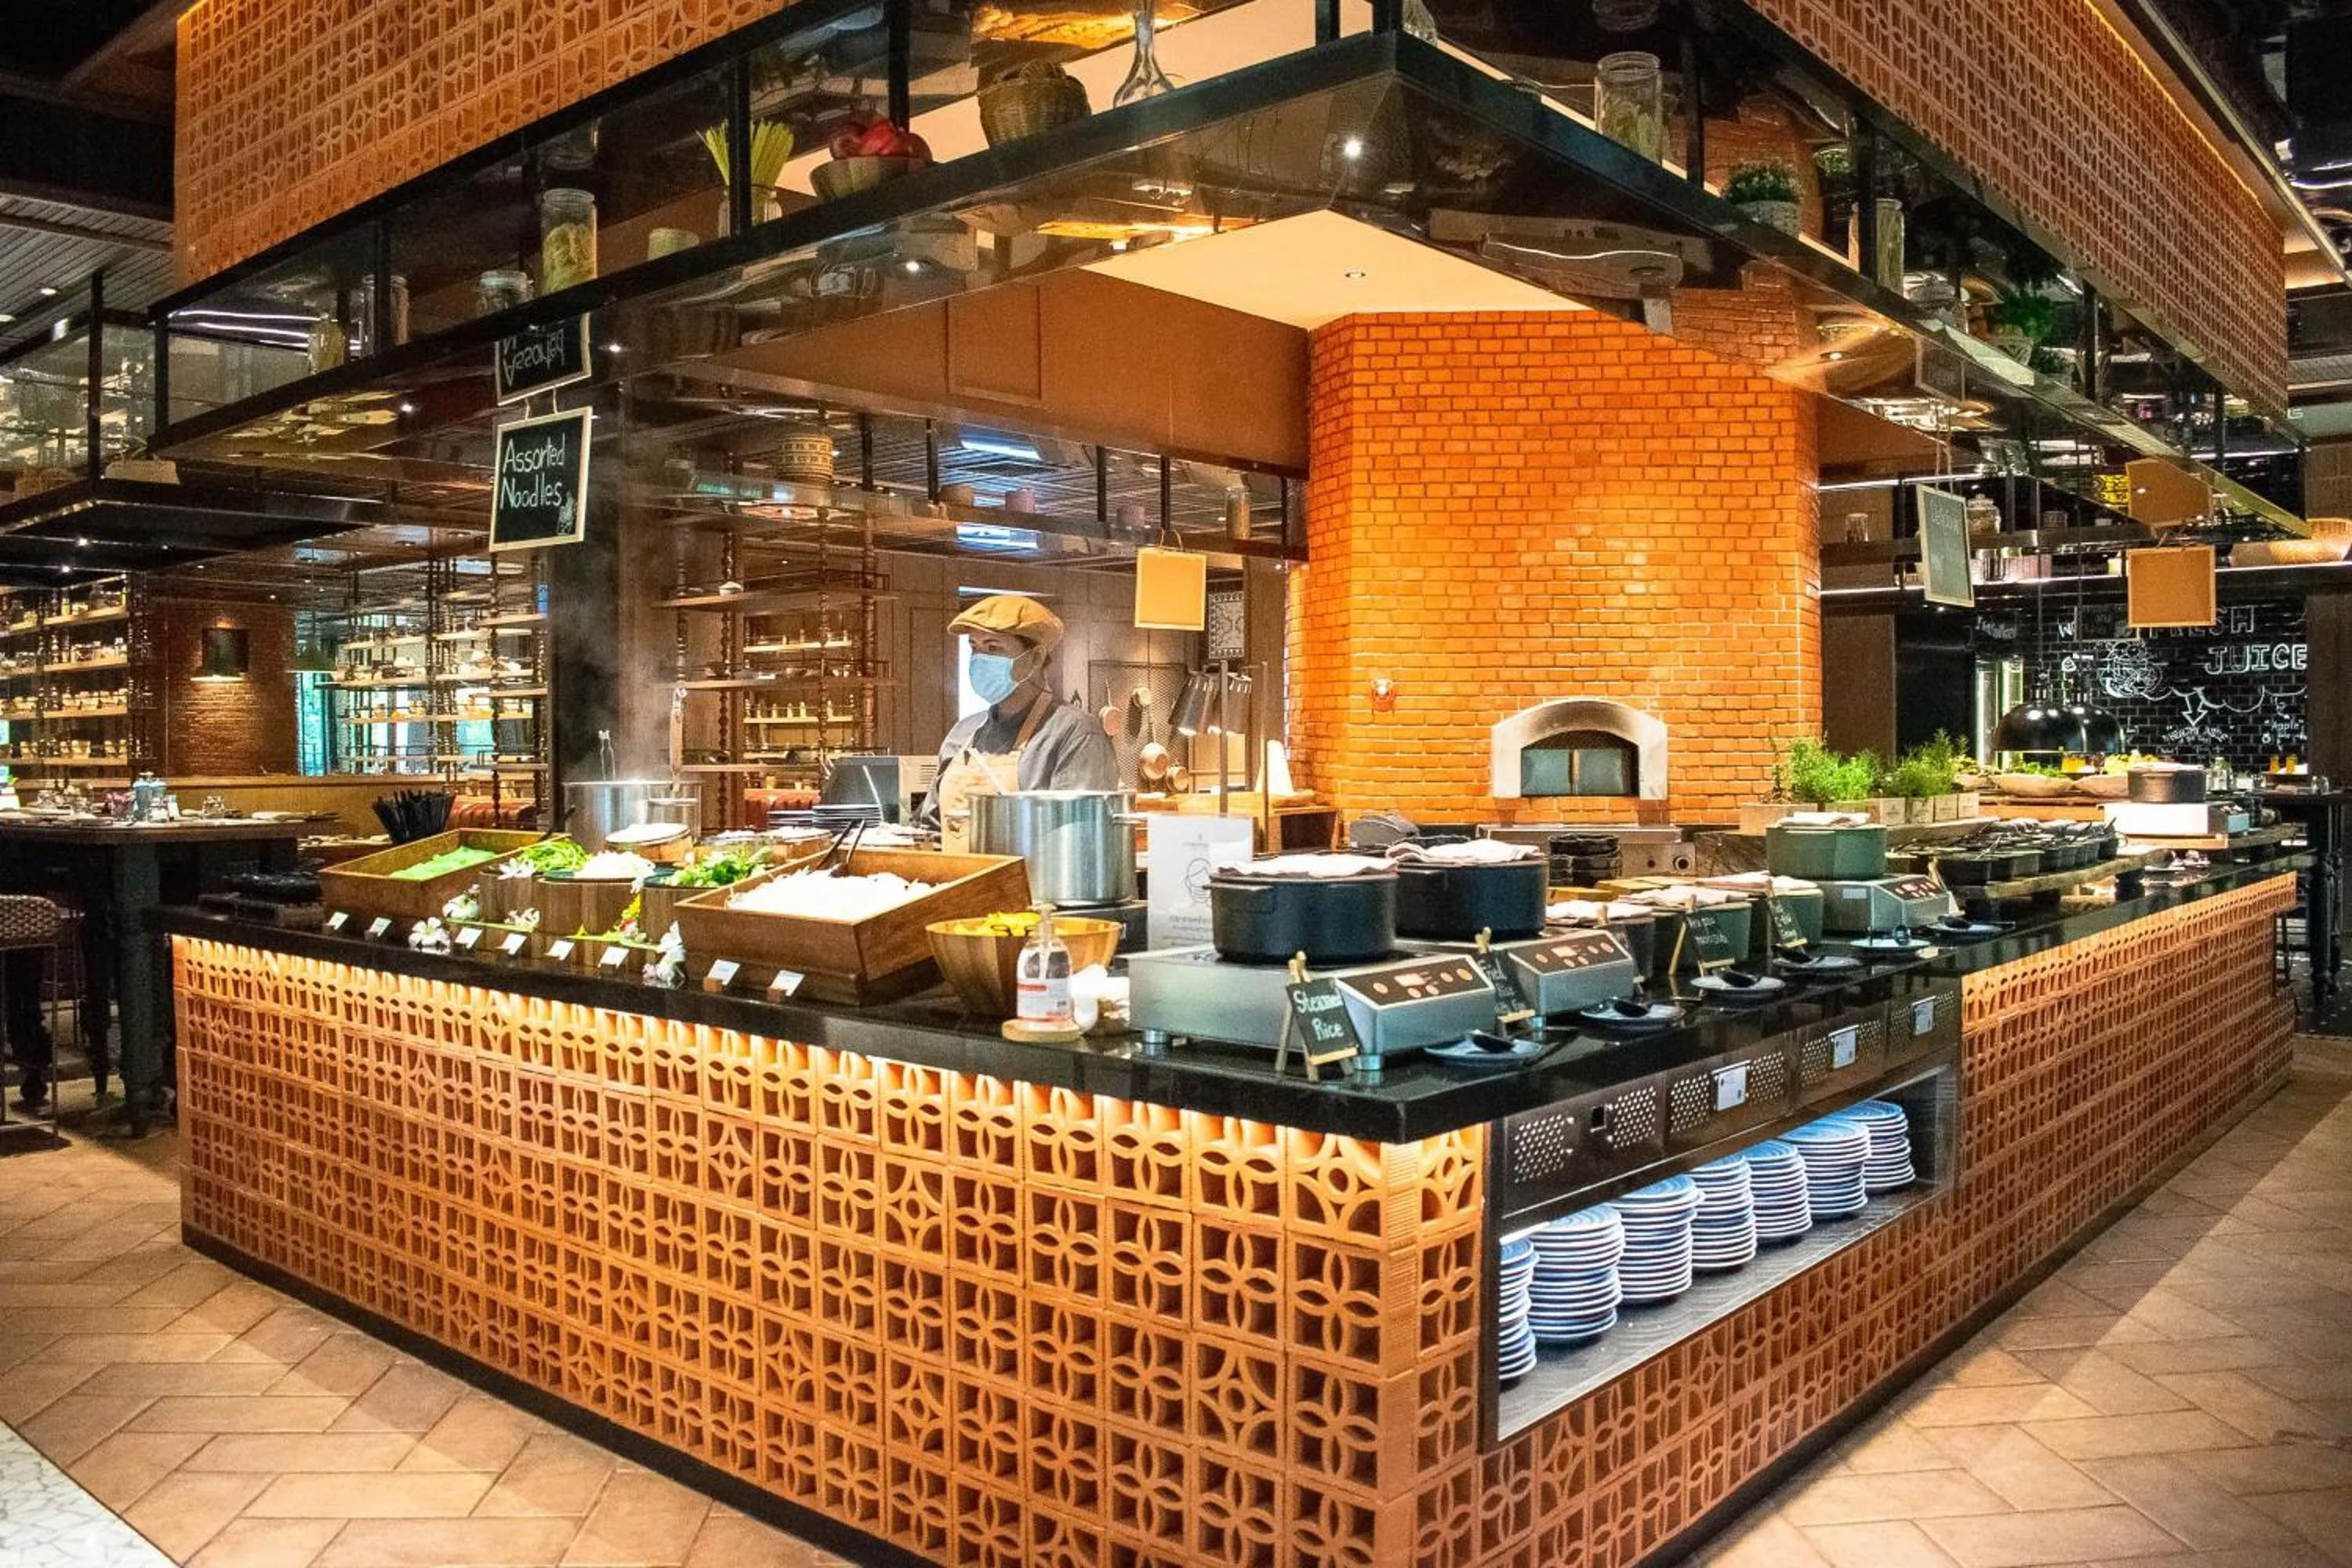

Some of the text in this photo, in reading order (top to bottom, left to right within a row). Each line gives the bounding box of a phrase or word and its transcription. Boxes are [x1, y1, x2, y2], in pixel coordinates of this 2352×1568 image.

[503, 433, 565, 474] Assorted
[499, 472, 562, 510] Noodles
[2204, 643, 2307, 674] JUICE
[1312, 1018, 1343, 1040] Rice
